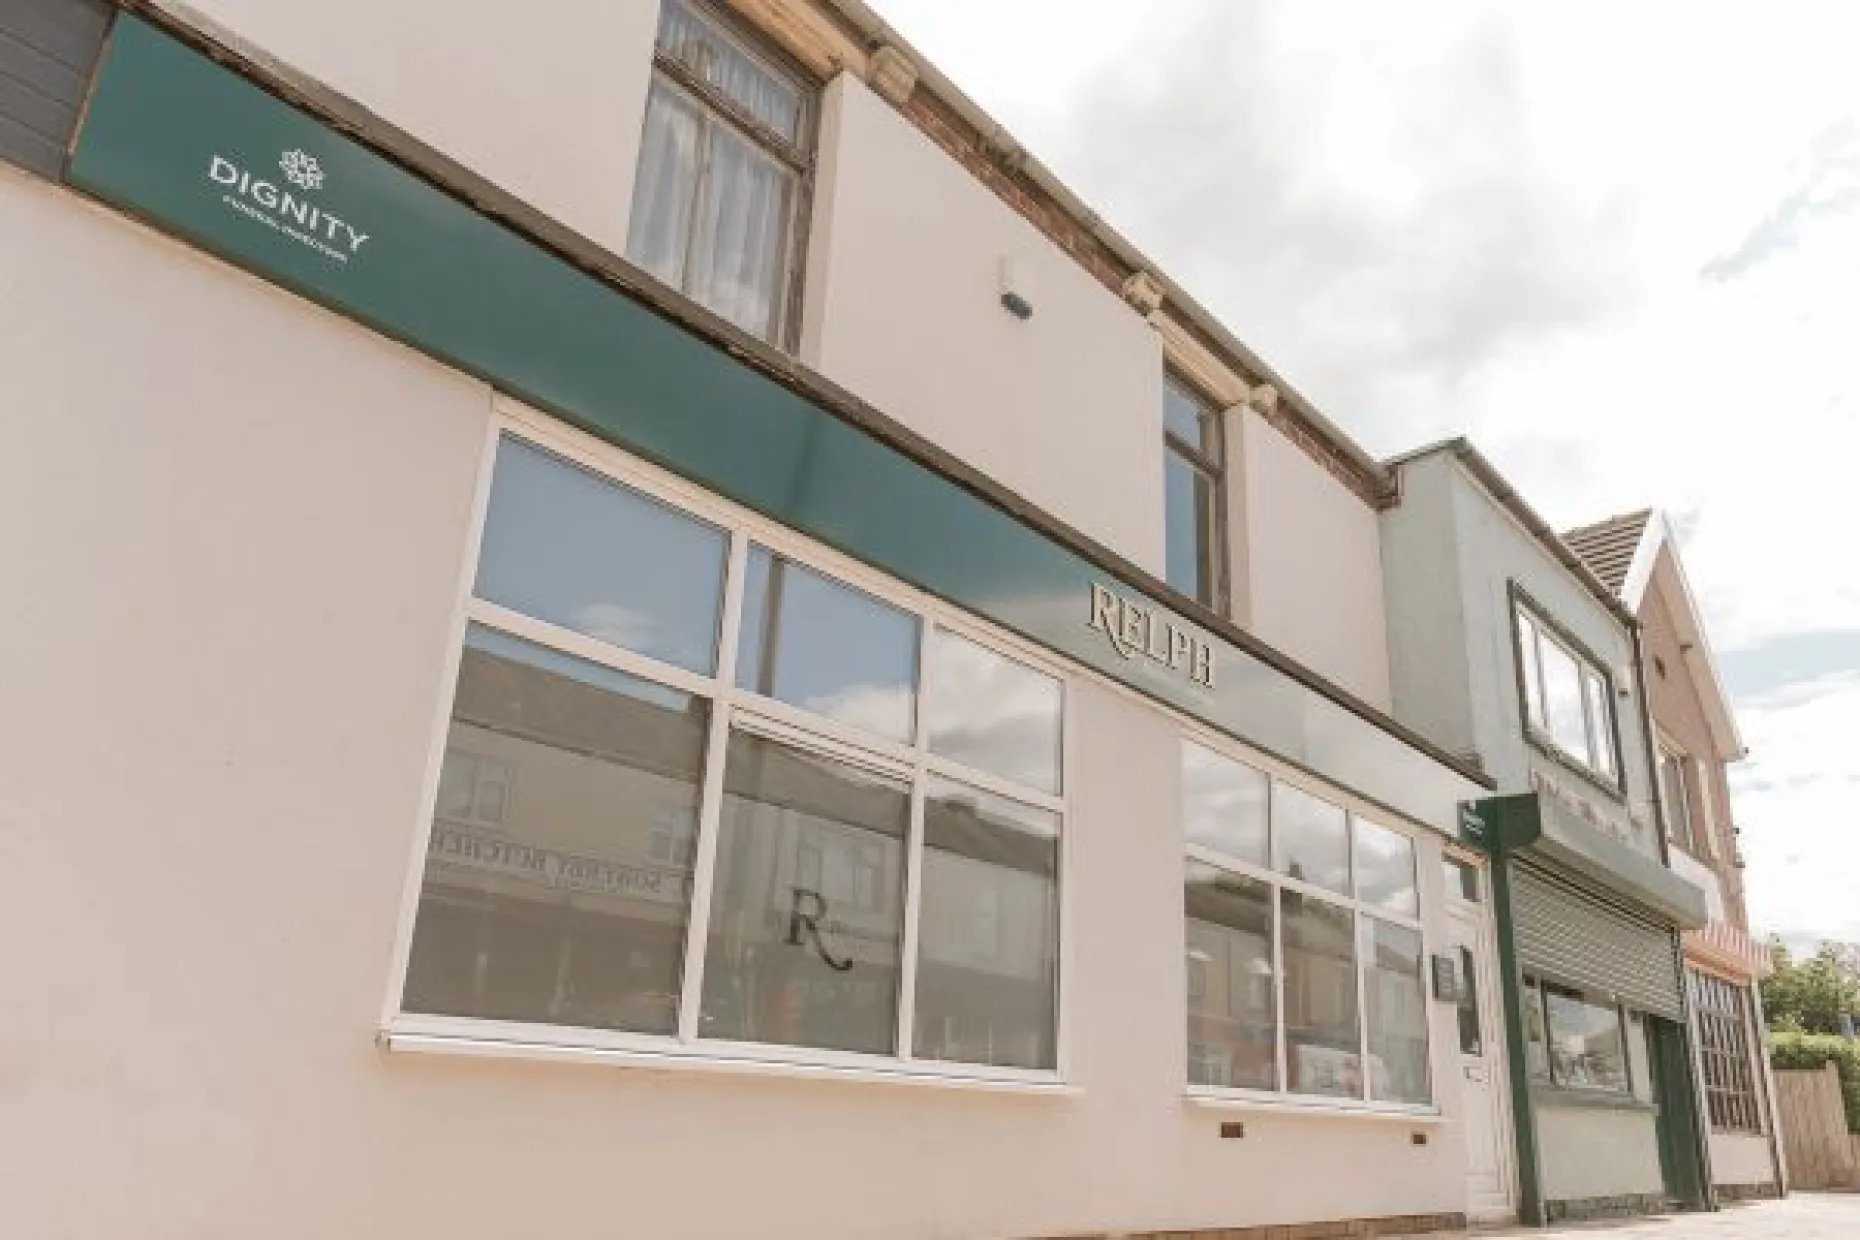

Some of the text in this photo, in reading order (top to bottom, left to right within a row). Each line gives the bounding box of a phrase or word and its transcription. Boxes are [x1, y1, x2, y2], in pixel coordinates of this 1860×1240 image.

[208, 155, 370, 252] DIGNITY
[1086, 581, 1216, 690] RELPH
[785, 887, 853, 972] R
